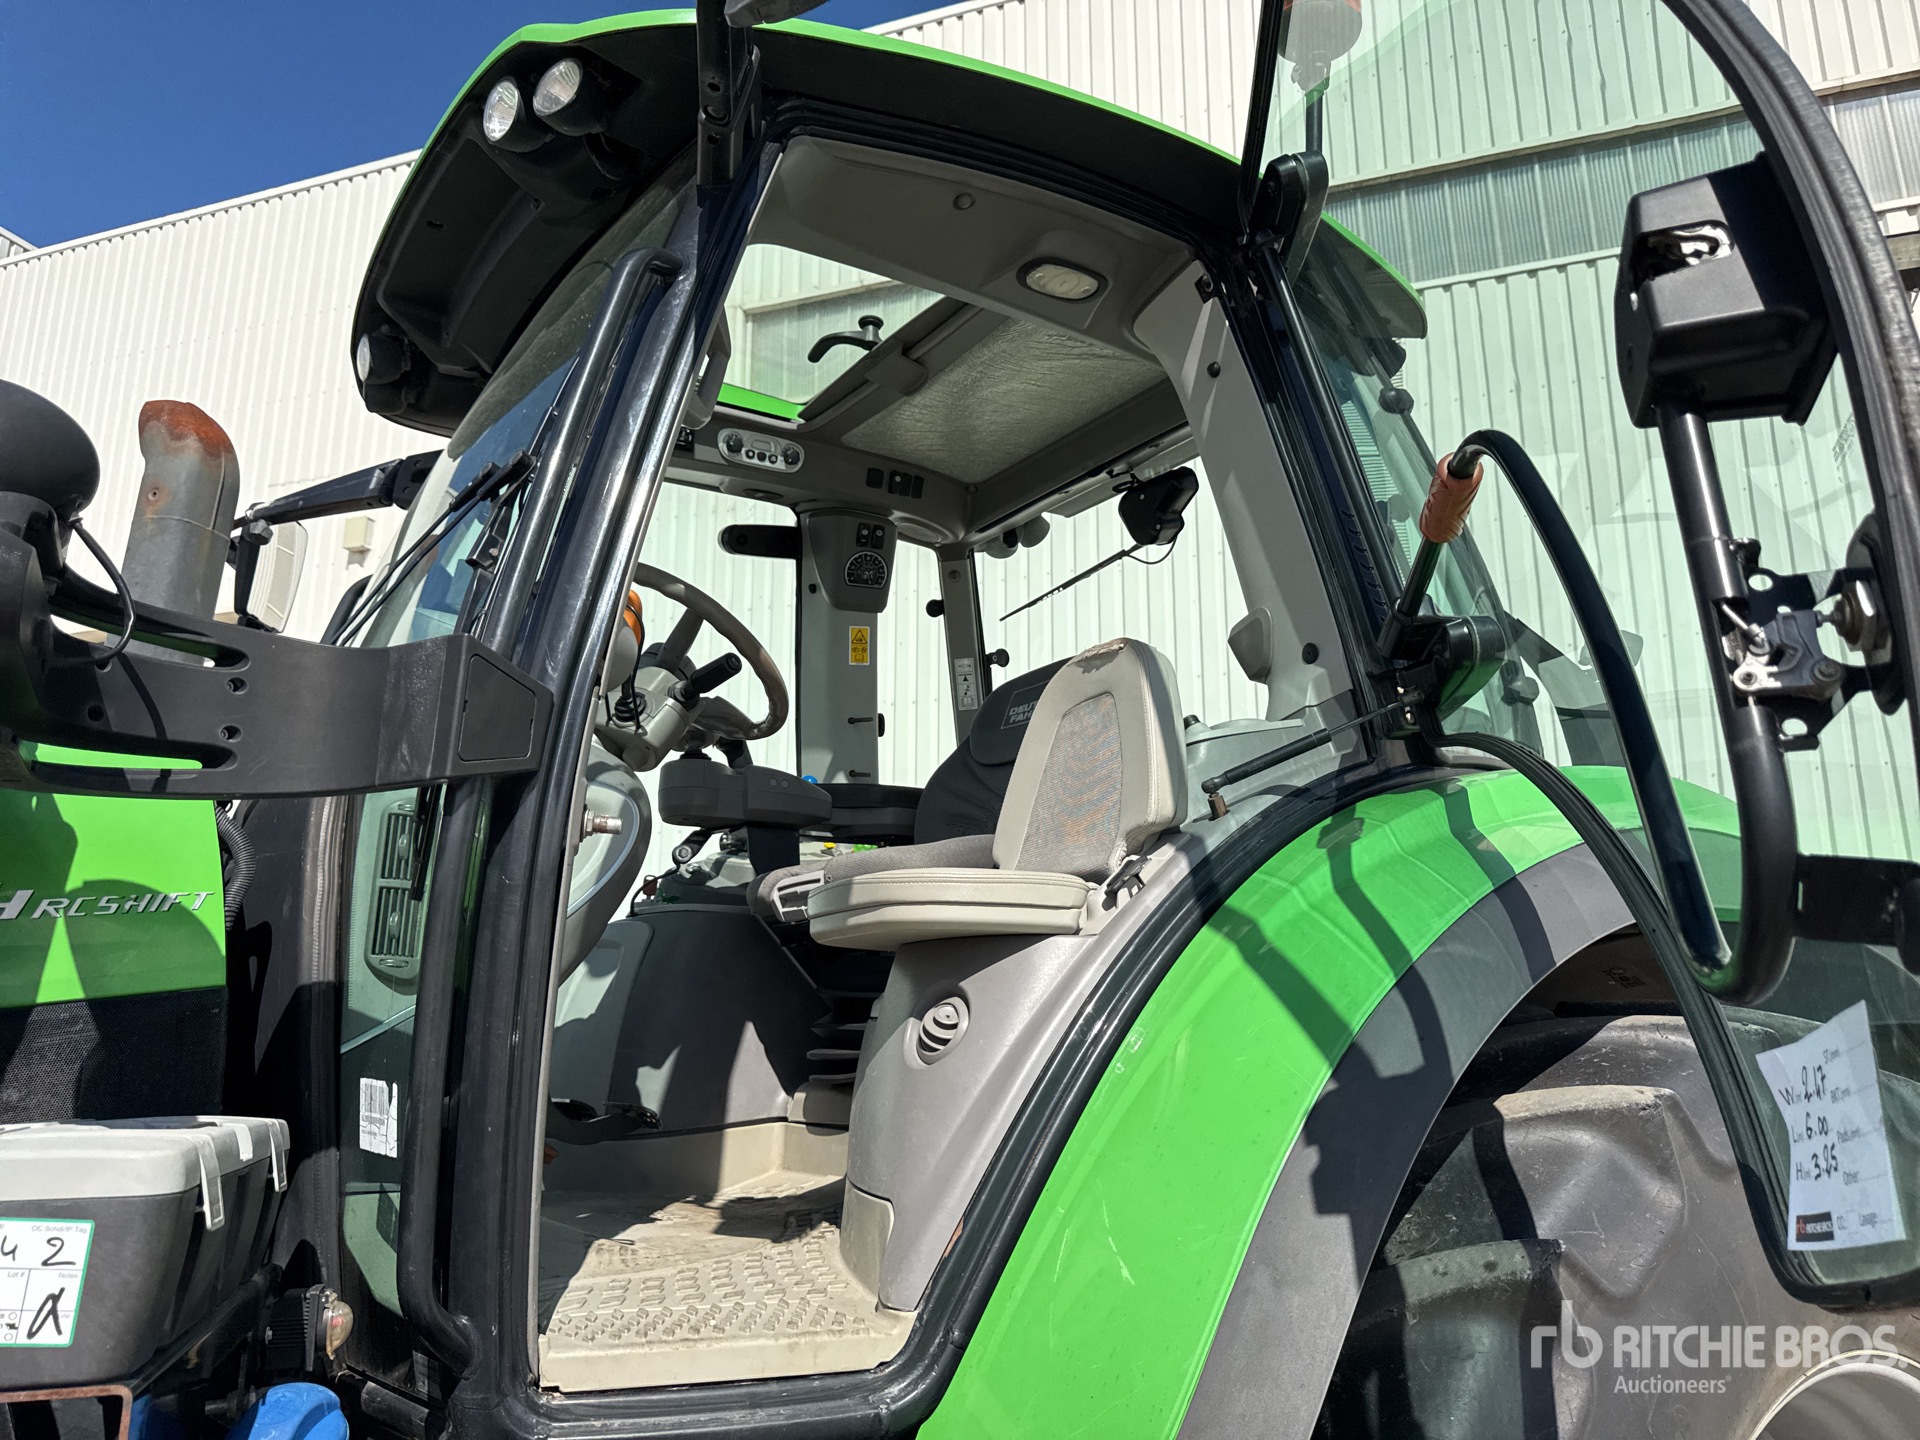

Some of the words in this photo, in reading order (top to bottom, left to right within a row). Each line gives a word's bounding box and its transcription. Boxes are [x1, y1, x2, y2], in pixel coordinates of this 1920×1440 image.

[1009, 700, 1039, 716] DEUT
[1009, 711, 1032, 723] FAH
[41, 1236, 77, 1267] 2
[7, 1270, 19, 1278] Lot
